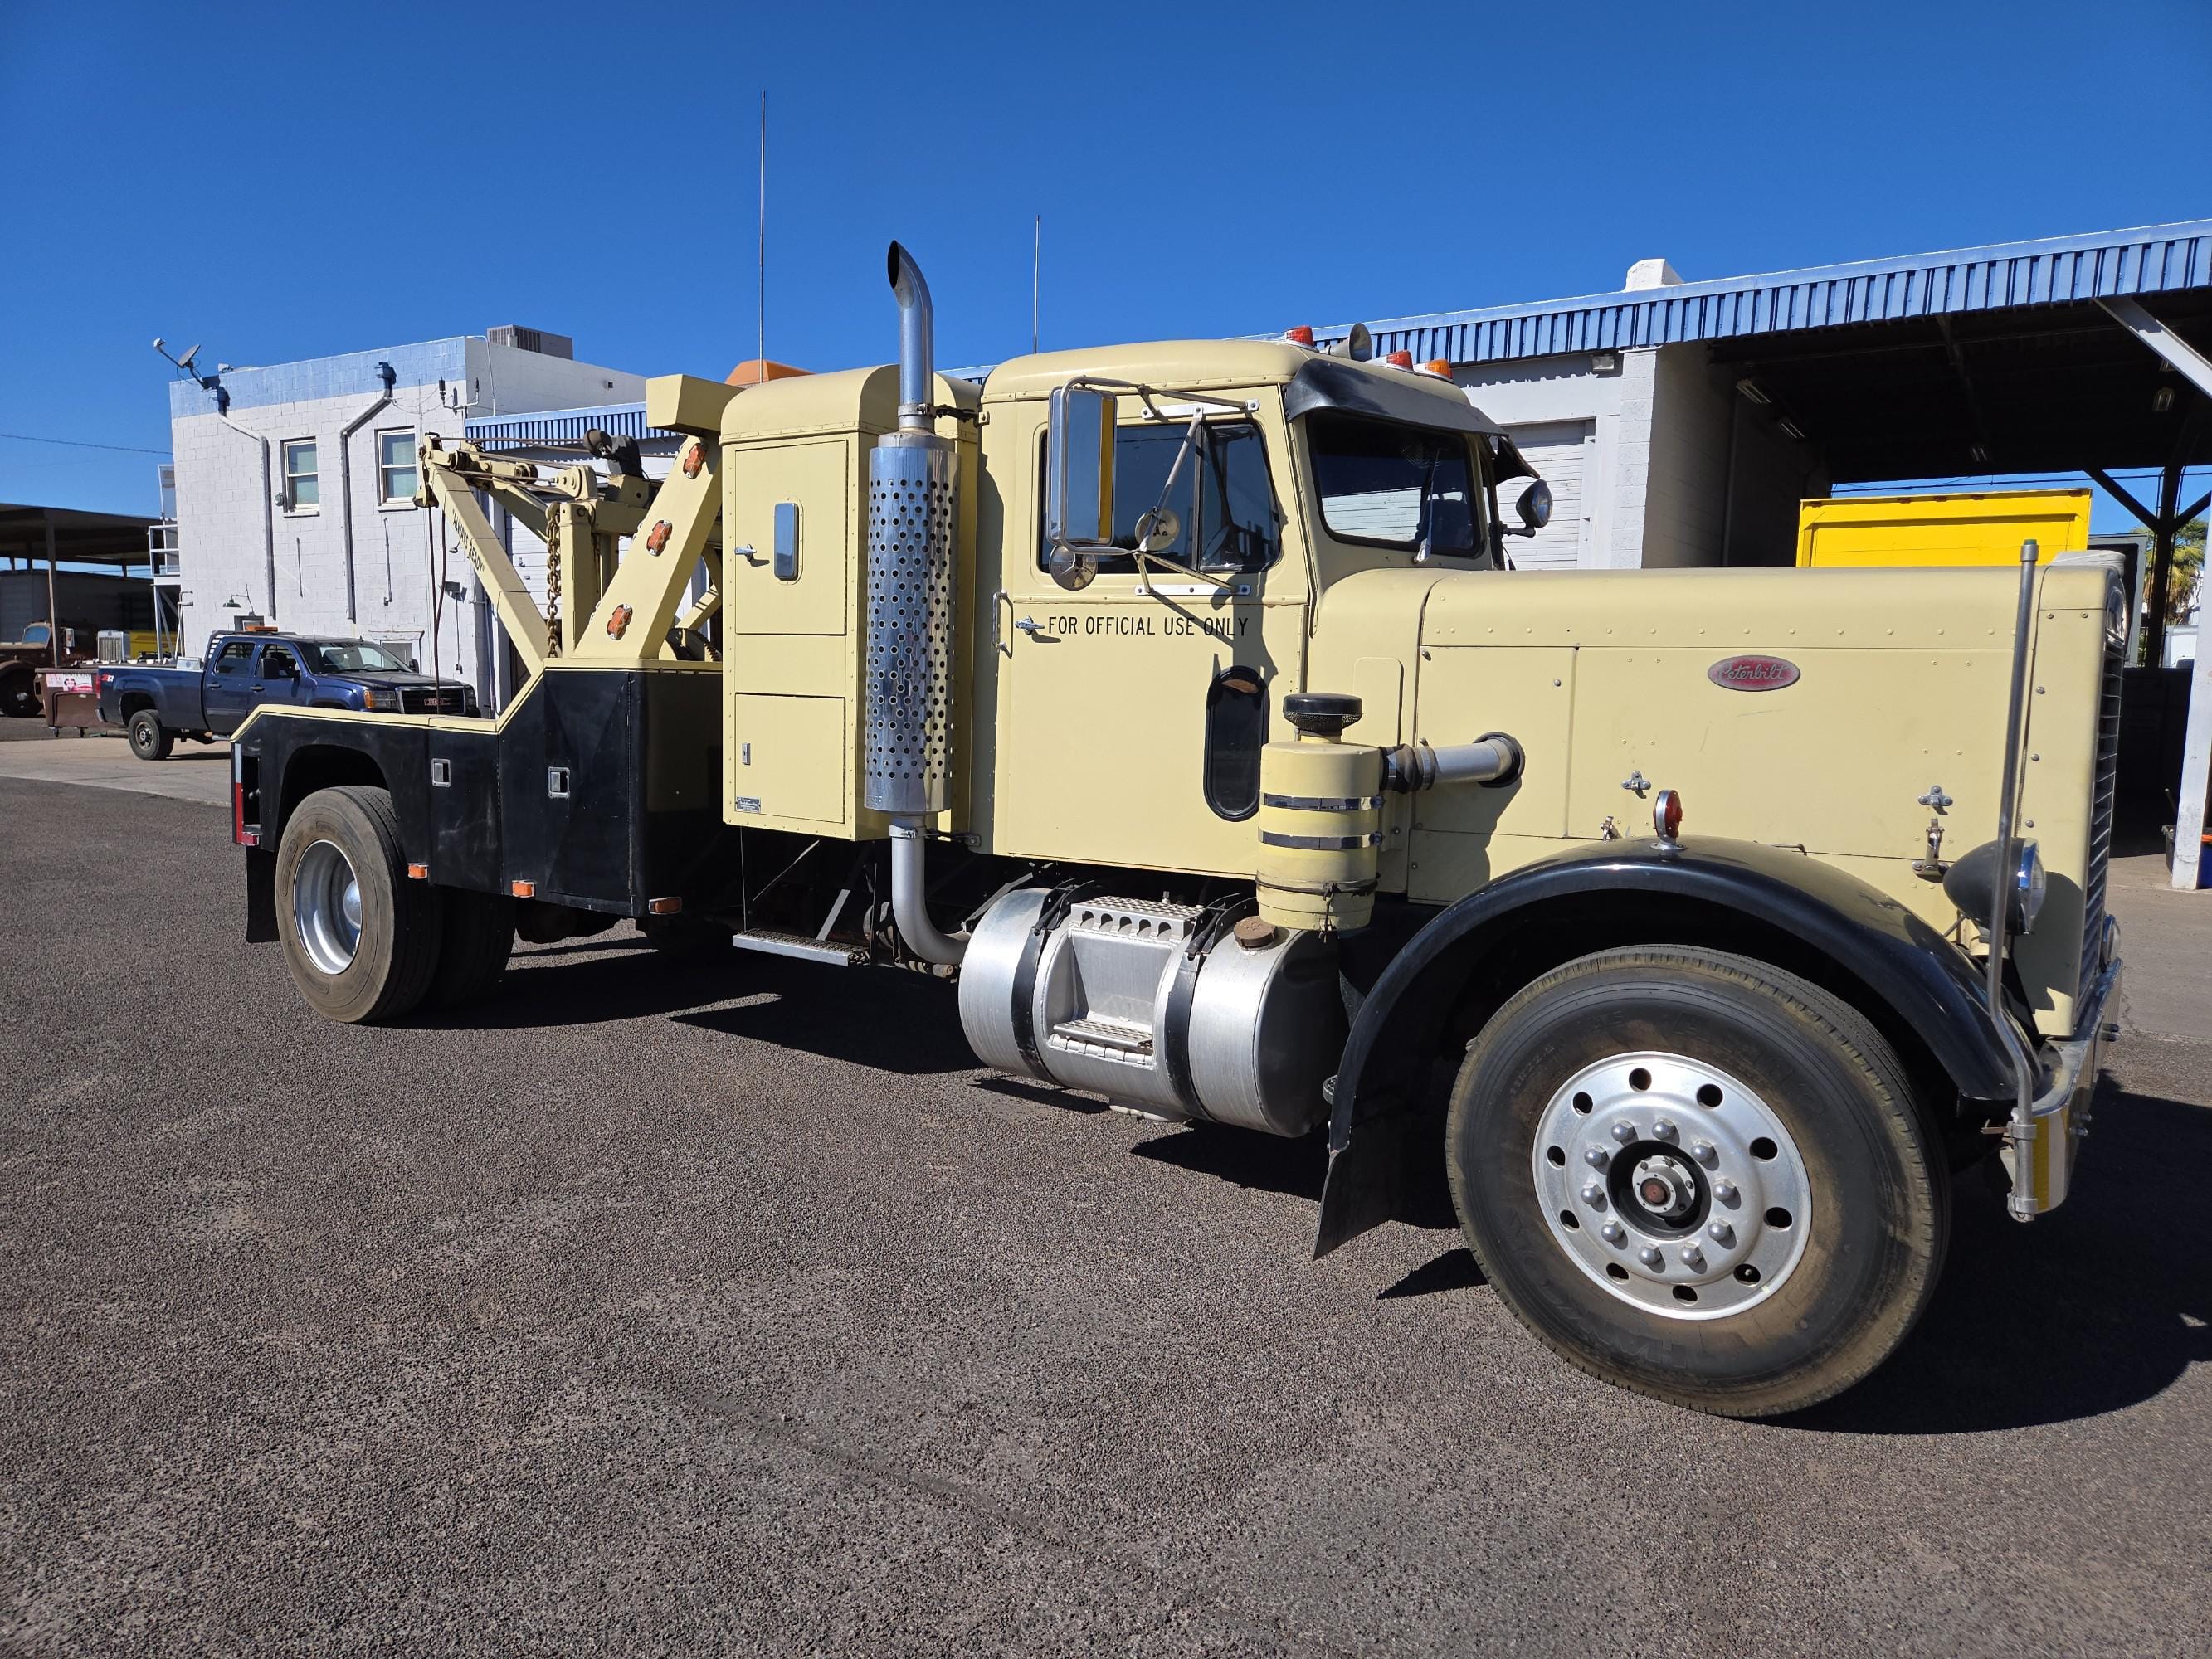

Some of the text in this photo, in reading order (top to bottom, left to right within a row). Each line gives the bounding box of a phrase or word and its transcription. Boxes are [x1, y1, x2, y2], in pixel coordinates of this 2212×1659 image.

[1048, 616, 1249, 637] FOR OFFICIAL USE ONLY
[1717, 663, 1791, 680] Peterbilt
